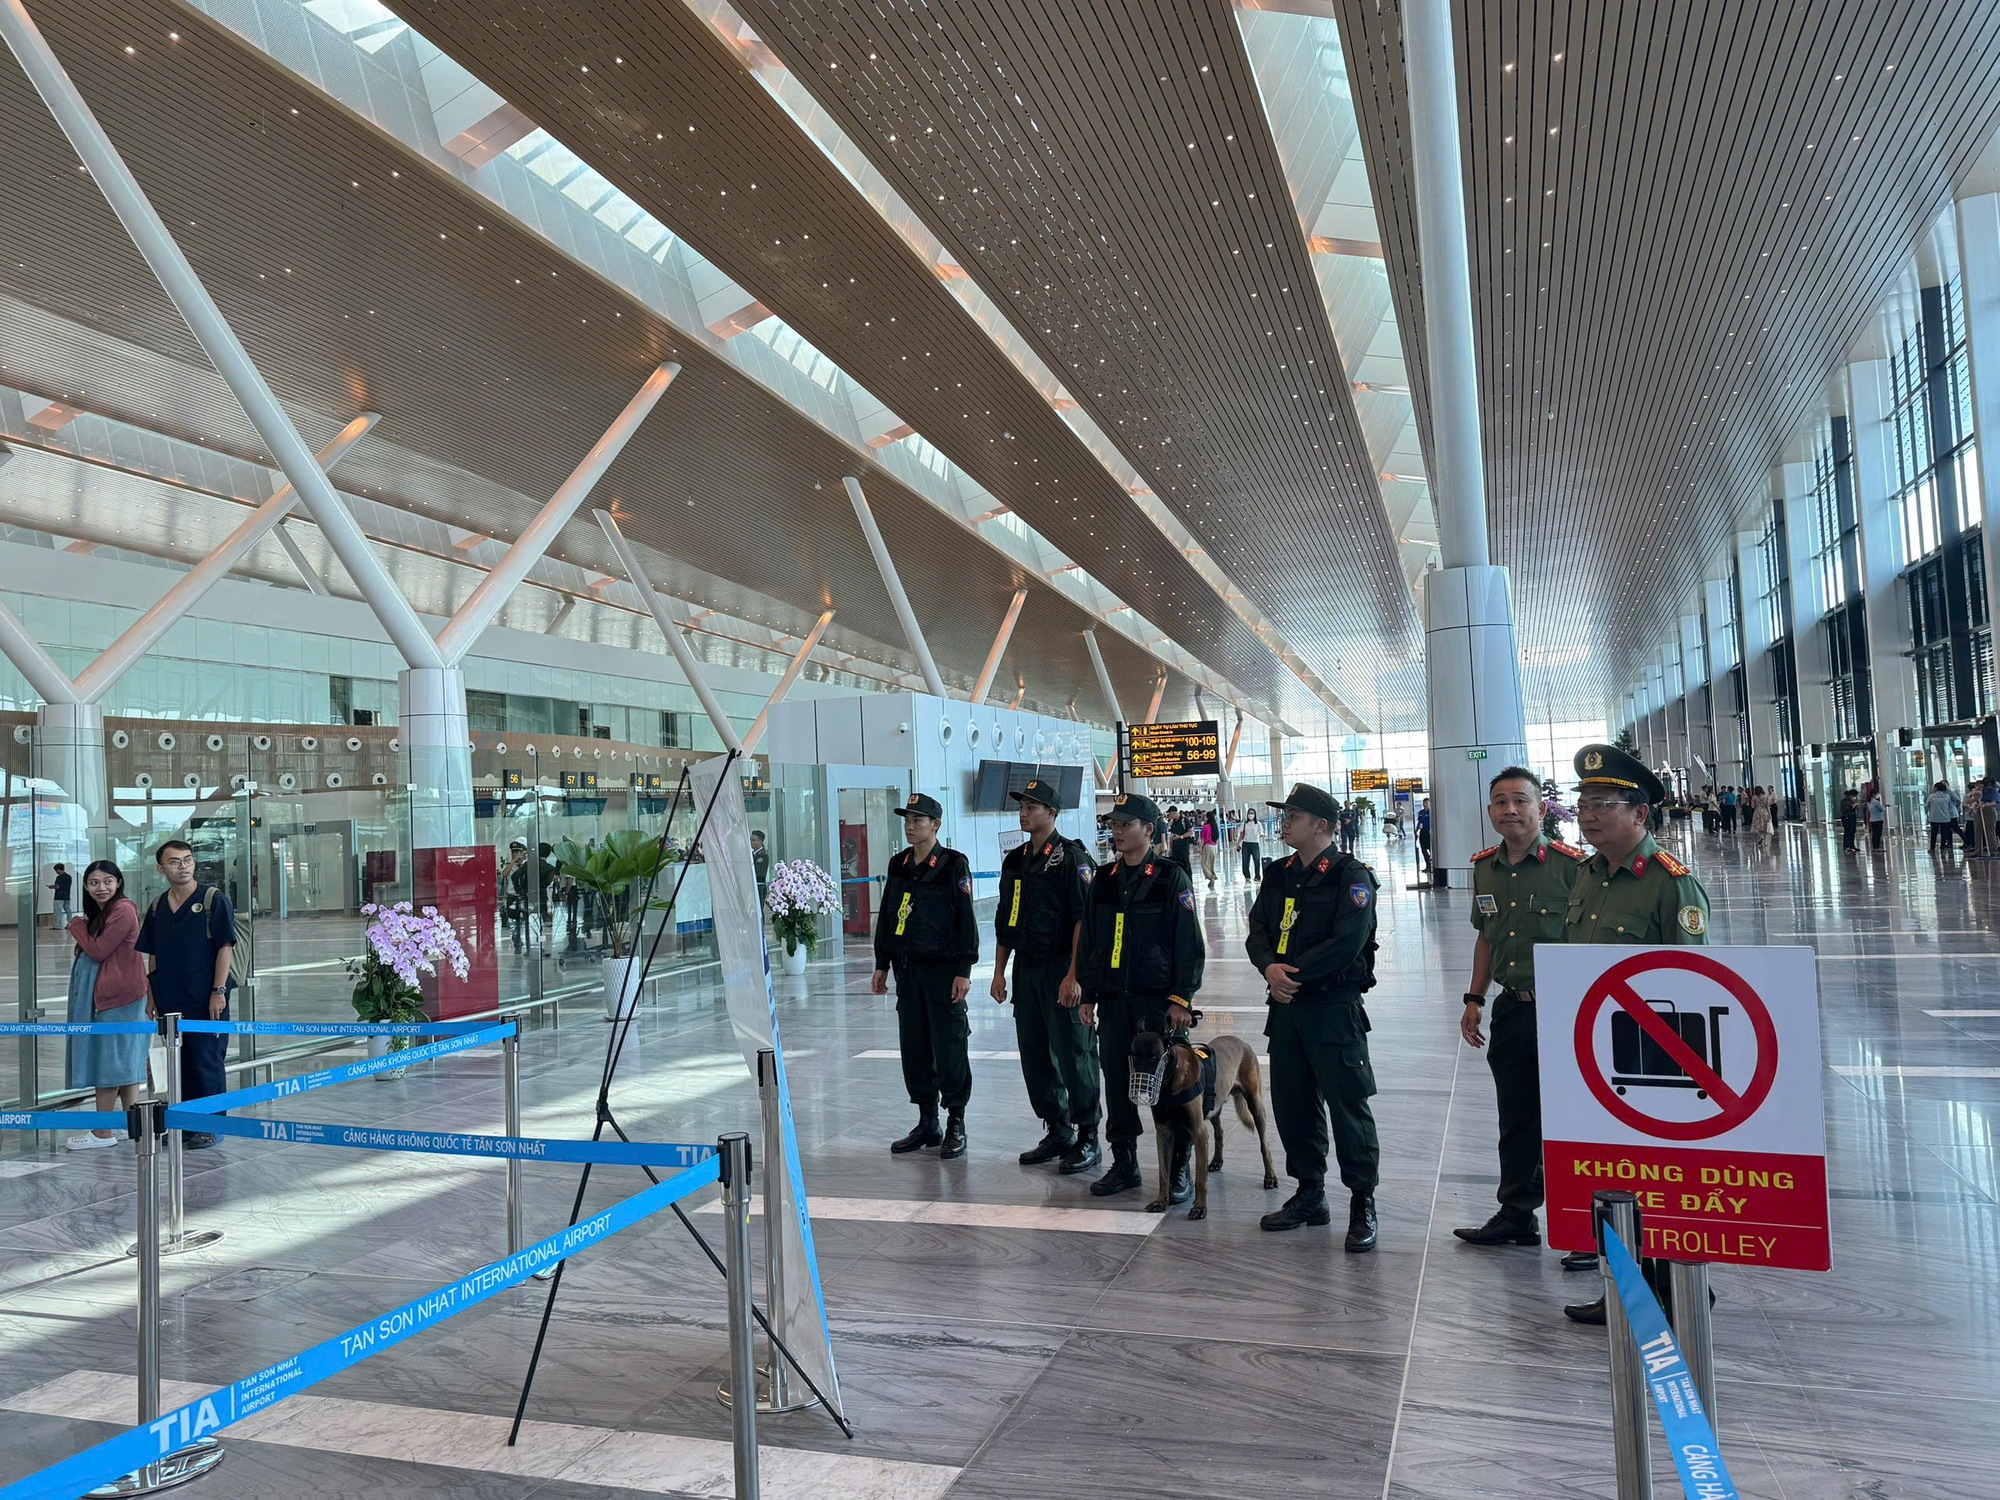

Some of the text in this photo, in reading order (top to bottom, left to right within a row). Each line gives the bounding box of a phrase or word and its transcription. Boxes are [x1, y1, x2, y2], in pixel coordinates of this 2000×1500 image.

[1187, 749, 1216, 760] 56-99
[510, 774, 518, 784] 56
[567, 776, 575, 784] 57
[588, 776, 594, 784] 58
[292, 1024, 304, 1032] TAN
[305, 1024, 320, 1033] SON
[321, 1025, 338, 1033] NHAT
[340, 1025, 390, 1034] INTERNATIONAL
[392, 1025, 421, 1034] AIRPORT
[274, 1078, 300, 1097] TIA
[260, 1122, 288, 1140] TIA
[343, 1128, 546, 1156] CẢNG HÀNG KHÔNG QUỐC TẾ TÂN SƠN NHẤT
[676, 1146, 712, 1166] TIA
[1574, 1158, 1794, 1190] KHÔNG DÙNG
[1680, 1188, 1748, 1214] ĐẨY
[1644, 1228, 1778, 1258] TROLLEY
[340, 1214, 612, 1358] TAN SON NHAT INTERNATIONAL AIRPORT
[1641, 1330, 1680, 1374] TIA
[241, 1356, 298, 1390] TAN SON NHAT
[241, 1367, 303, 1402] INTERNATIONAL
[241, 1391, 276, 1414] AIRPORT
[150, 1397, 220, 1454] TIA
[1682, 1444, 1718, 1479] CẢNG
